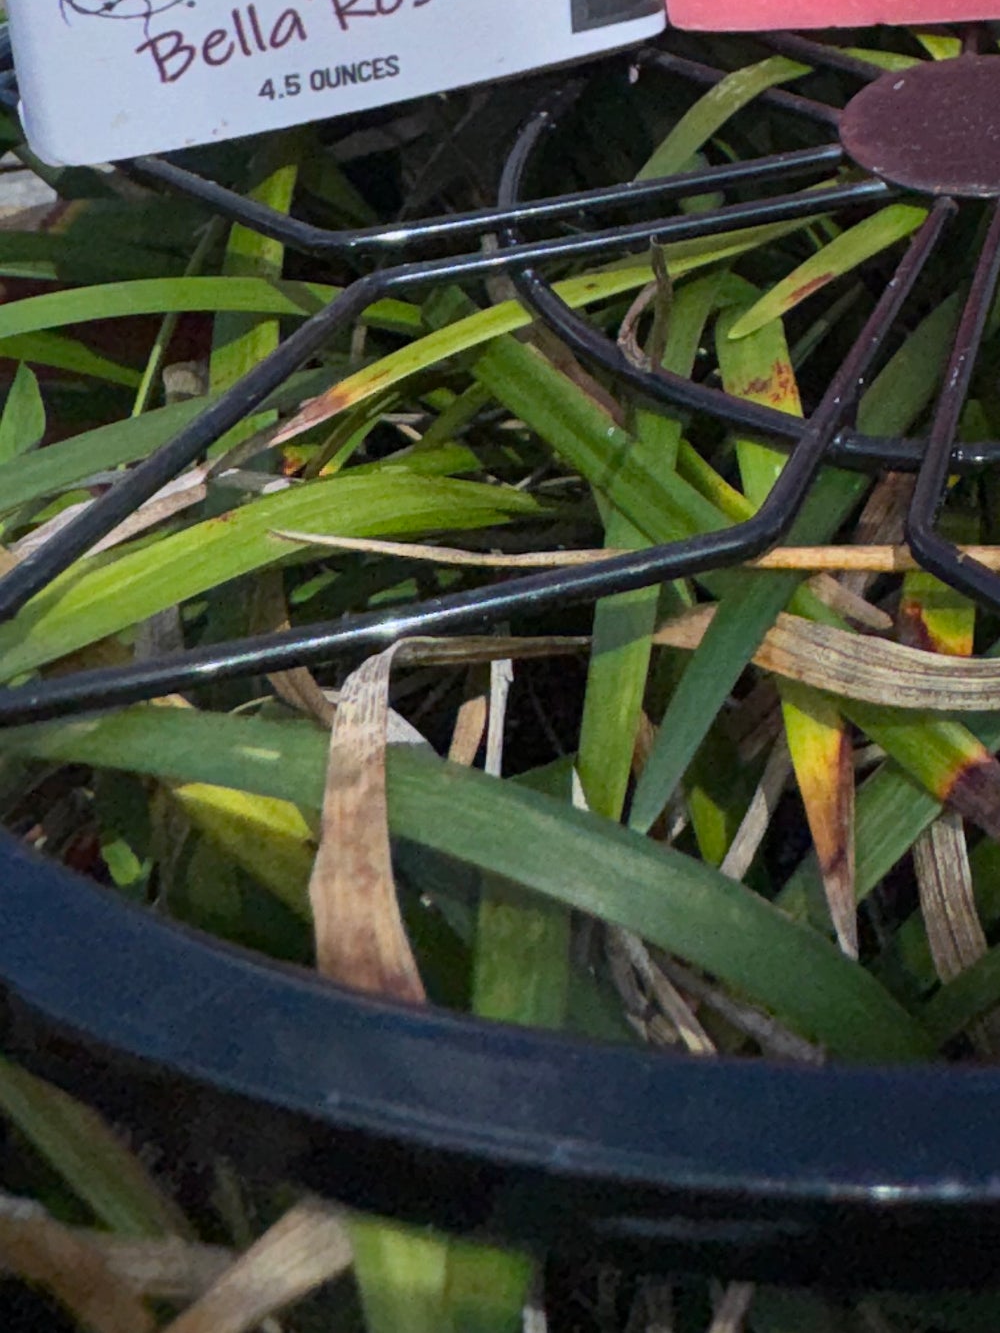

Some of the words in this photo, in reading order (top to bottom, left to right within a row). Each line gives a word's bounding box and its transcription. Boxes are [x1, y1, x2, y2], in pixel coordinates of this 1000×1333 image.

[136, 3, 308, 84] Bella
[257, 72, 302, 101] 4.5
[309, 54, 401, 91] OUNCES
